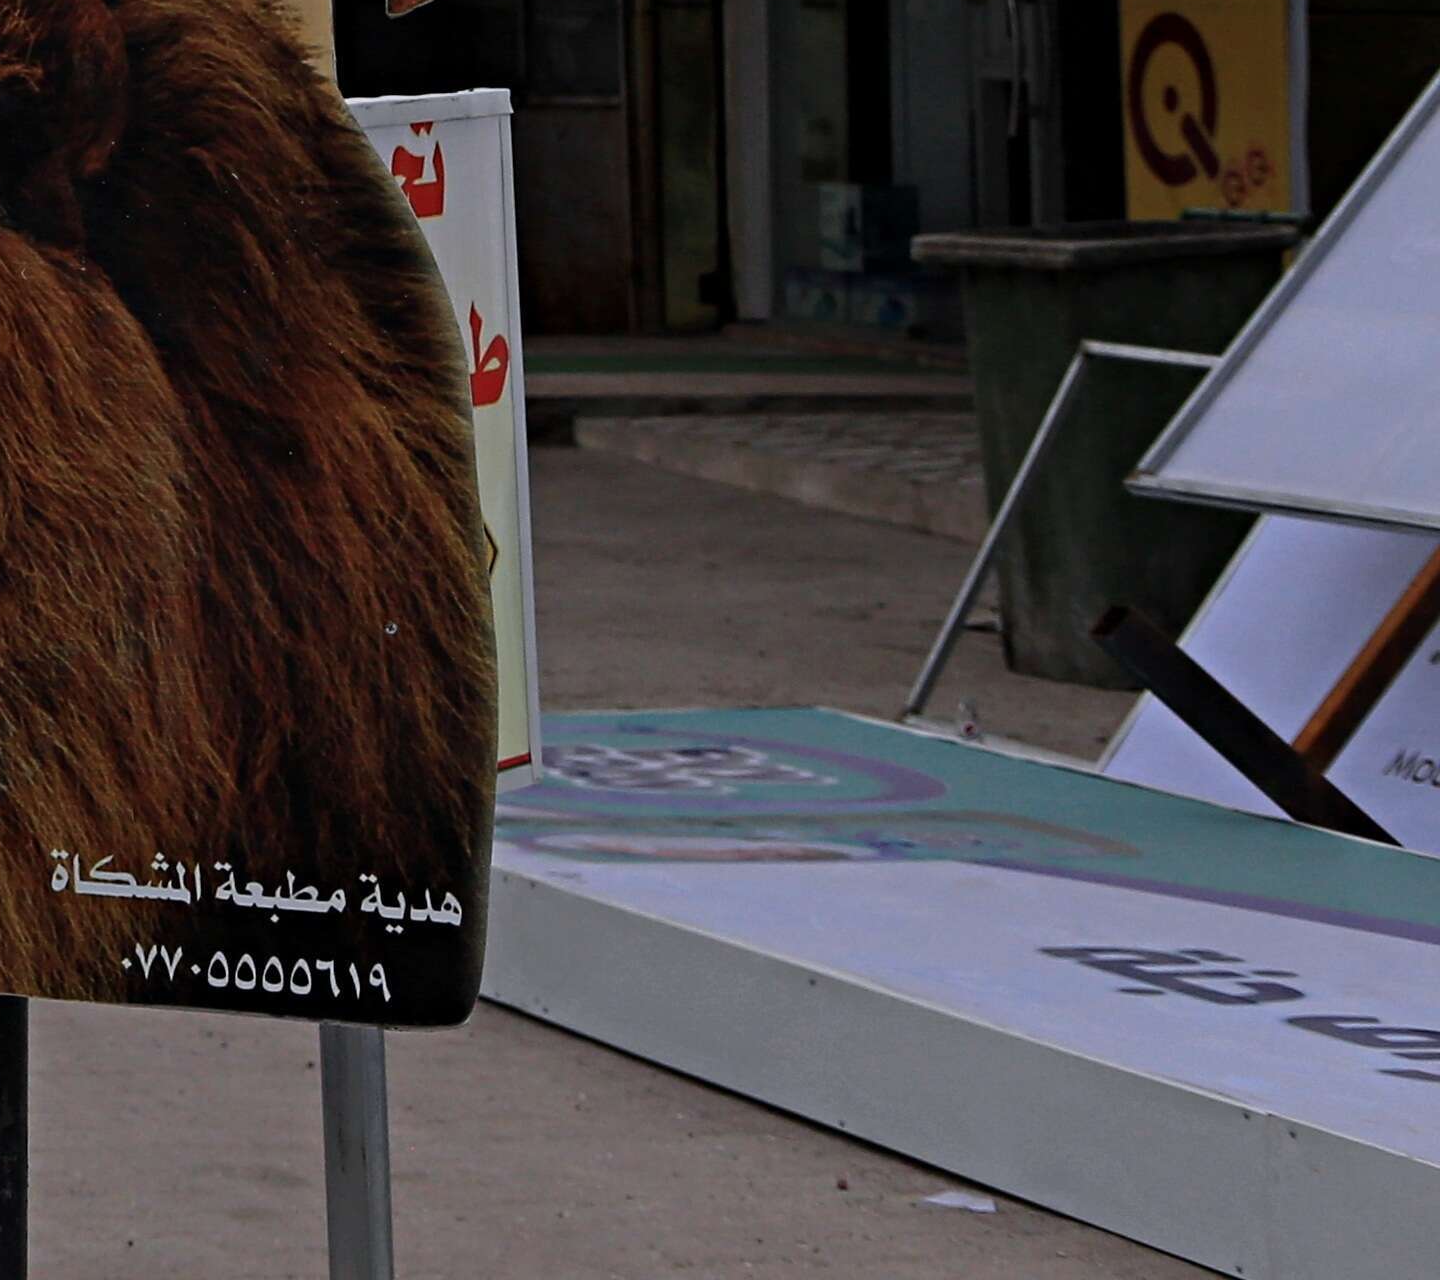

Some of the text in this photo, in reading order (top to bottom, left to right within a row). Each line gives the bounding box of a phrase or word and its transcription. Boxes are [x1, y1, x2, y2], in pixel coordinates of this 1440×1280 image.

[49, 847, 464, 935] هدية مطبعة المشكاة
[122, 942, 393, 1003] ٠٧٧٠٥٥٥٥٦١٩
